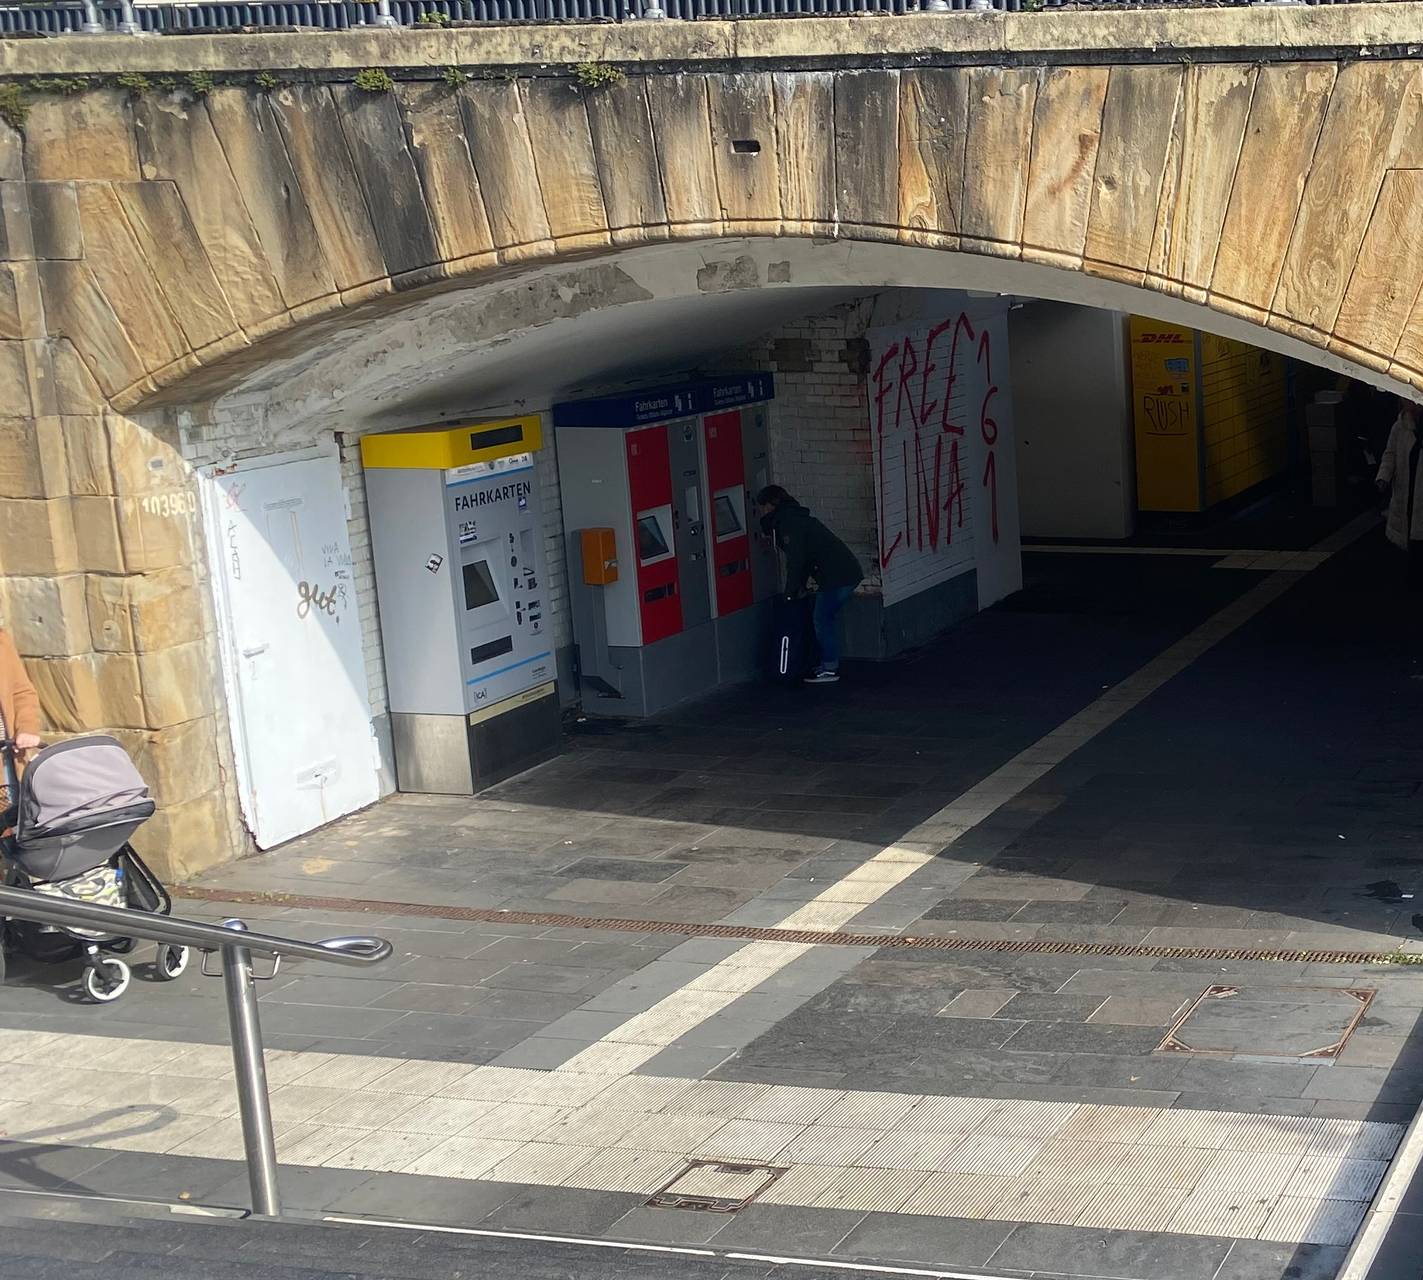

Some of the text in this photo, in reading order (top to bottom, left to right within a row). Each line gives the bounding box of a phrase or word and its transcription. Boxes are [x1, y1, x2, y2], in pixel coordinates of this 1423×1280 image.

[1138, 333, 1185, 344] DHL
[872, 312, 974, 434] FREE
[635, 399, 669, 412] Fahrkarten
[1143, 395, 1191, 432] RUSH
[455, 480, 532, 512] FAHRKARTEN
